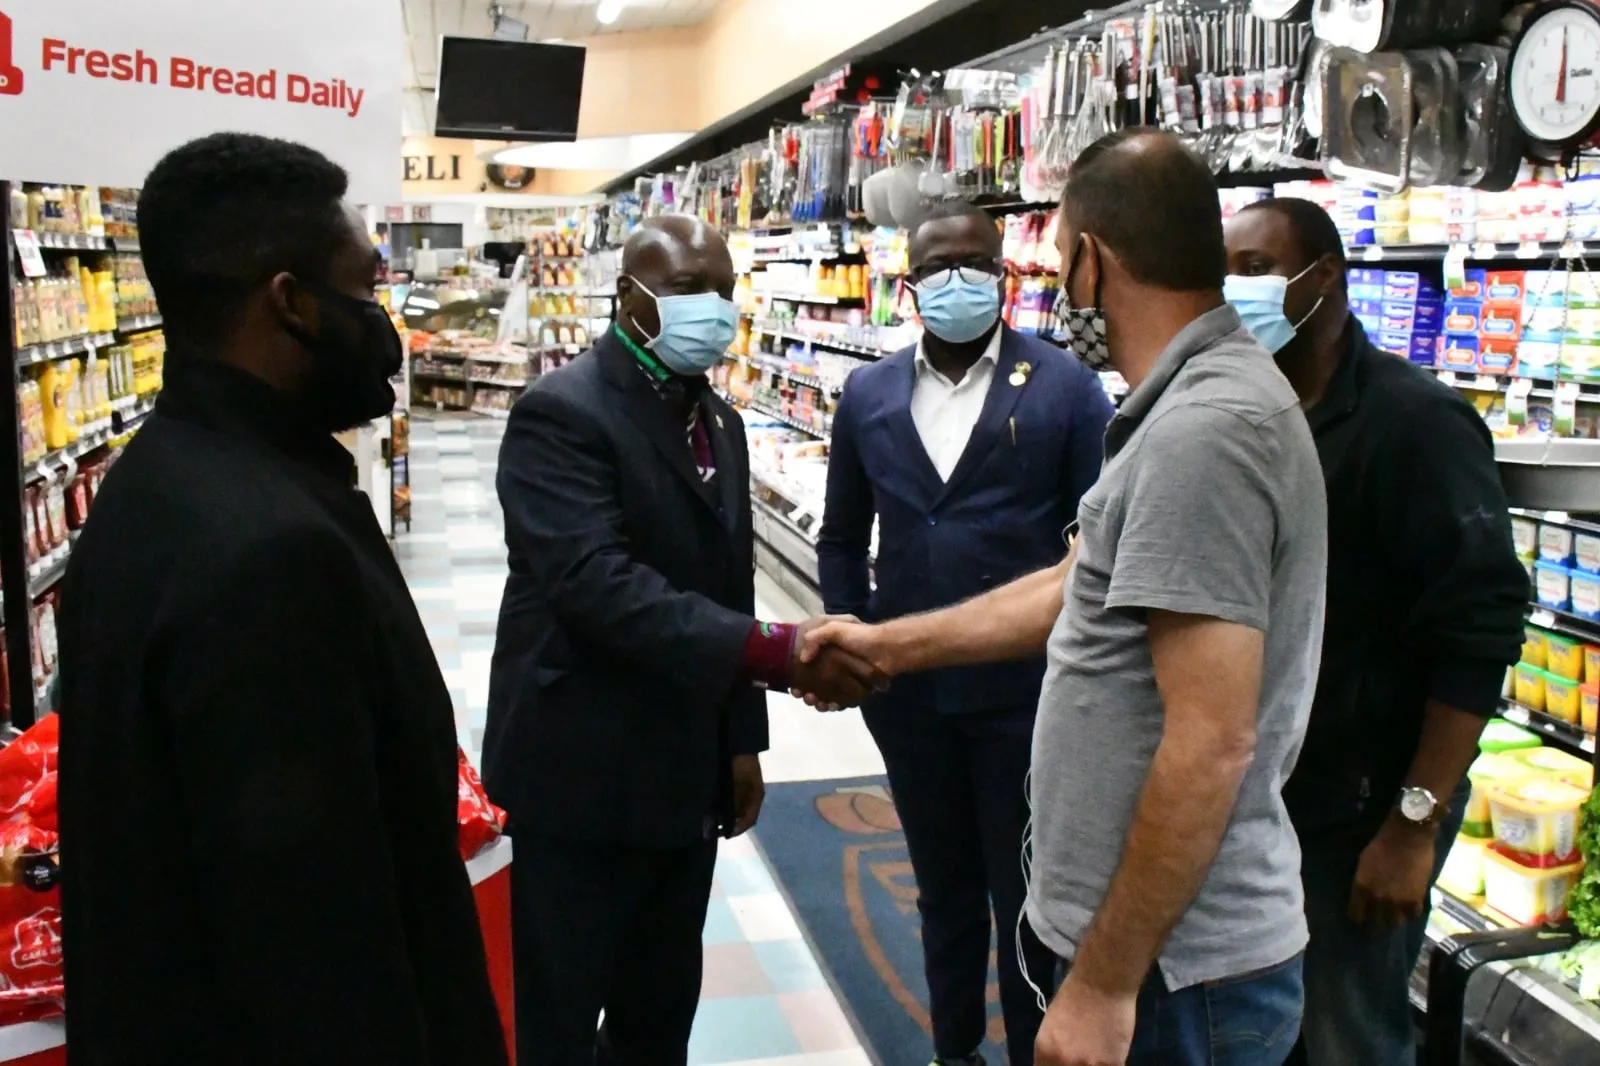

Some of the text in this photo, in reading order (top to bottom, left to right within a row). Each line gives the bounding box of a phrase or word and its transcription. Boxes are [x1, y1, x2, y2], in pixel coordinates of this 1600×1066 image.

[42, 38, 364, 118] Fresh Bread Daily
[402, 154, 462, 181] ELI
